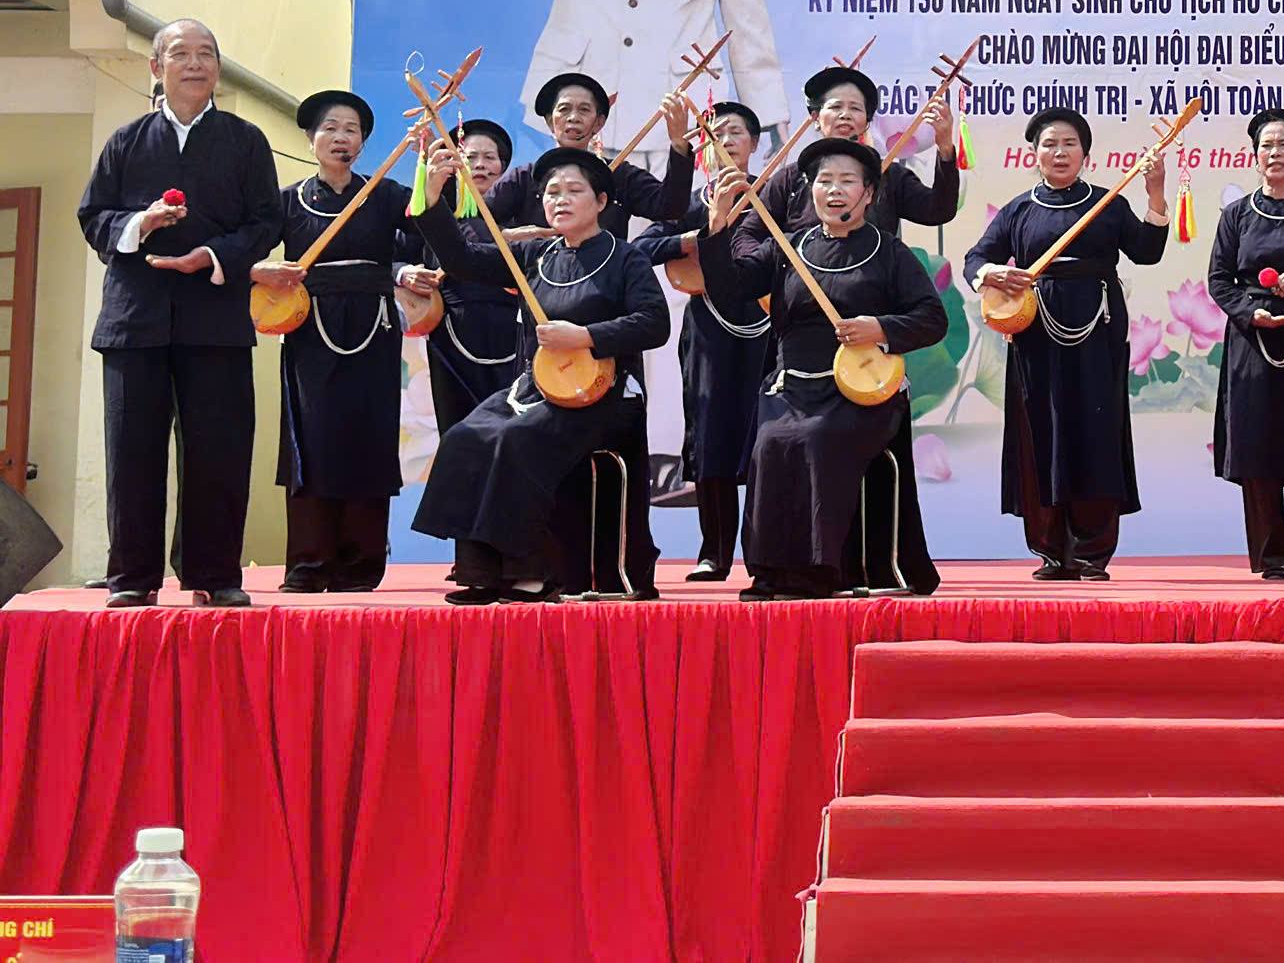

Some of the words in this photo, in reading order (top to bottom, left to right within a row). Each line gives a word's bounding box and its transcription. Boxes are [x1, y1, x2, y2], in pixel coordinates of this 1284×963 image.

[977, 29, 1041, 65] CHÀO
[1042, 29, 1106, 65] MỪNG
[1111, 35, 1148, 72] ĐẠI
[1155, 29, 1190, 72] HỘI
[1197, 35, 1233, 72] ĐẠI
[877, 79, 918, 115] CÁC
[959, 79, 1019, 115] CHỨC
[1022, 79, 1088, 115] CHÍNH
[1095, 85, 1127, 122] TRỊ
[1149, 79, 1178, 115] XÃ
[1226, 79, 1282, 115] TOÀN
[1004, 146, 1040, 169] Hò
[1176, 147, 1201, 169] 16
[22, 917, 54, 938] CHÍ
